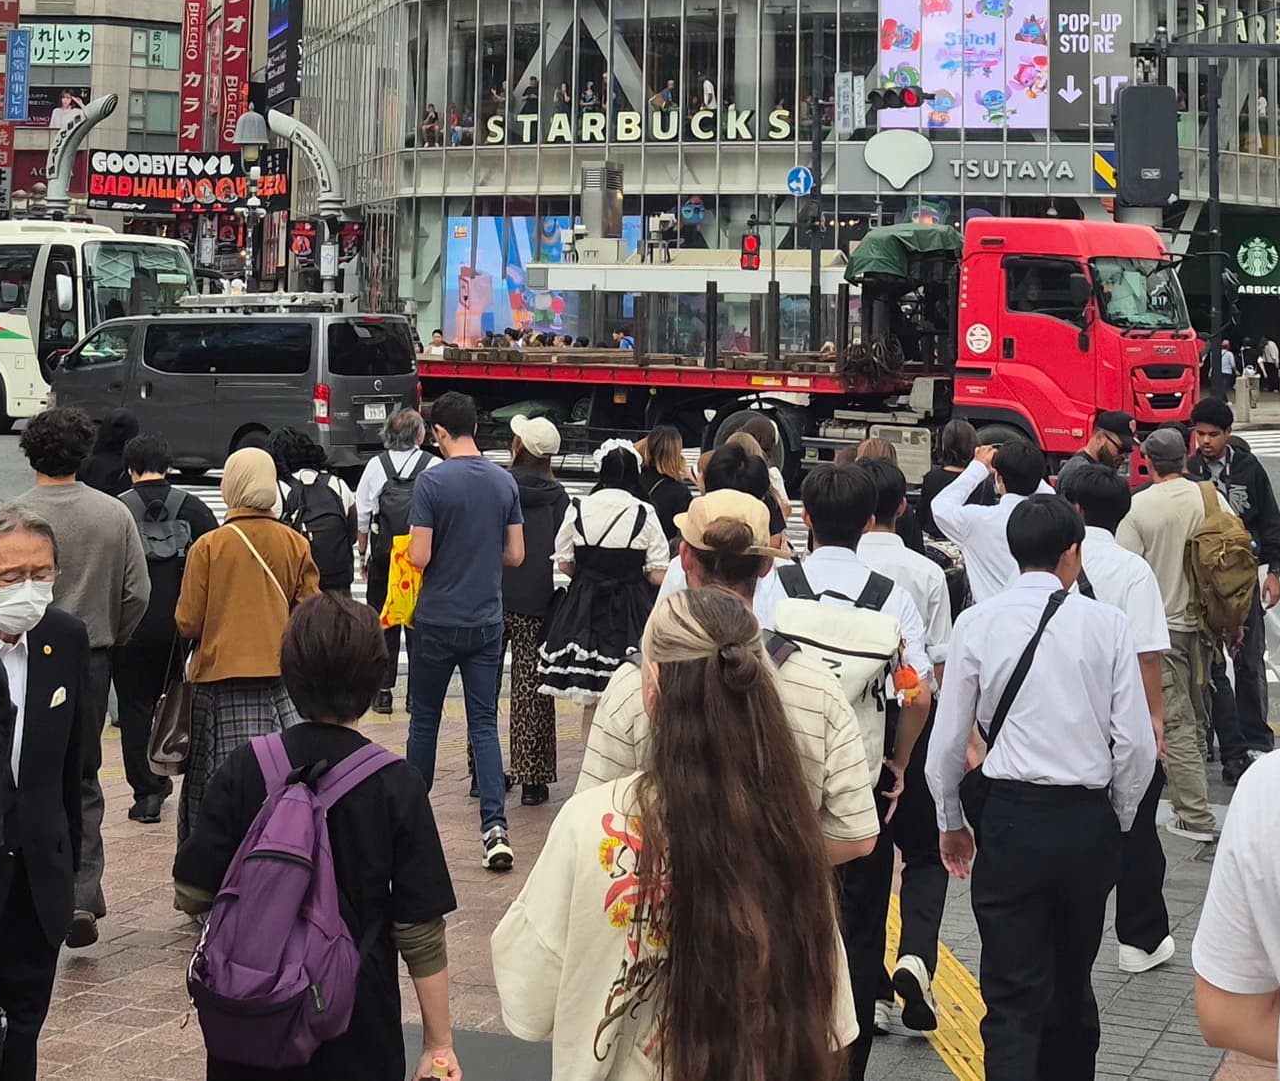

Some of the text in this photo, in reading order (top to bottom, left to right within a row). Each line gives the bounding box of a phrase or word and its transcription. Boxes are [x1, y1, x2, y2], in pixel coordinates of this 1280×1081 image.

[1058, 13, 1122, 33] POP-UP
[1059, 33, 1115, 53] STORE
[33, 46, 91, 63] リニック
[180, 70, 203, 153] カラオ
[487, 105, 792, 144] STARBUCKS
[91, 150, 188, 176] GOODBYE
[949, 159, 1075, 180] TSUTAYA
[90, 173, 133, 197] BAD
